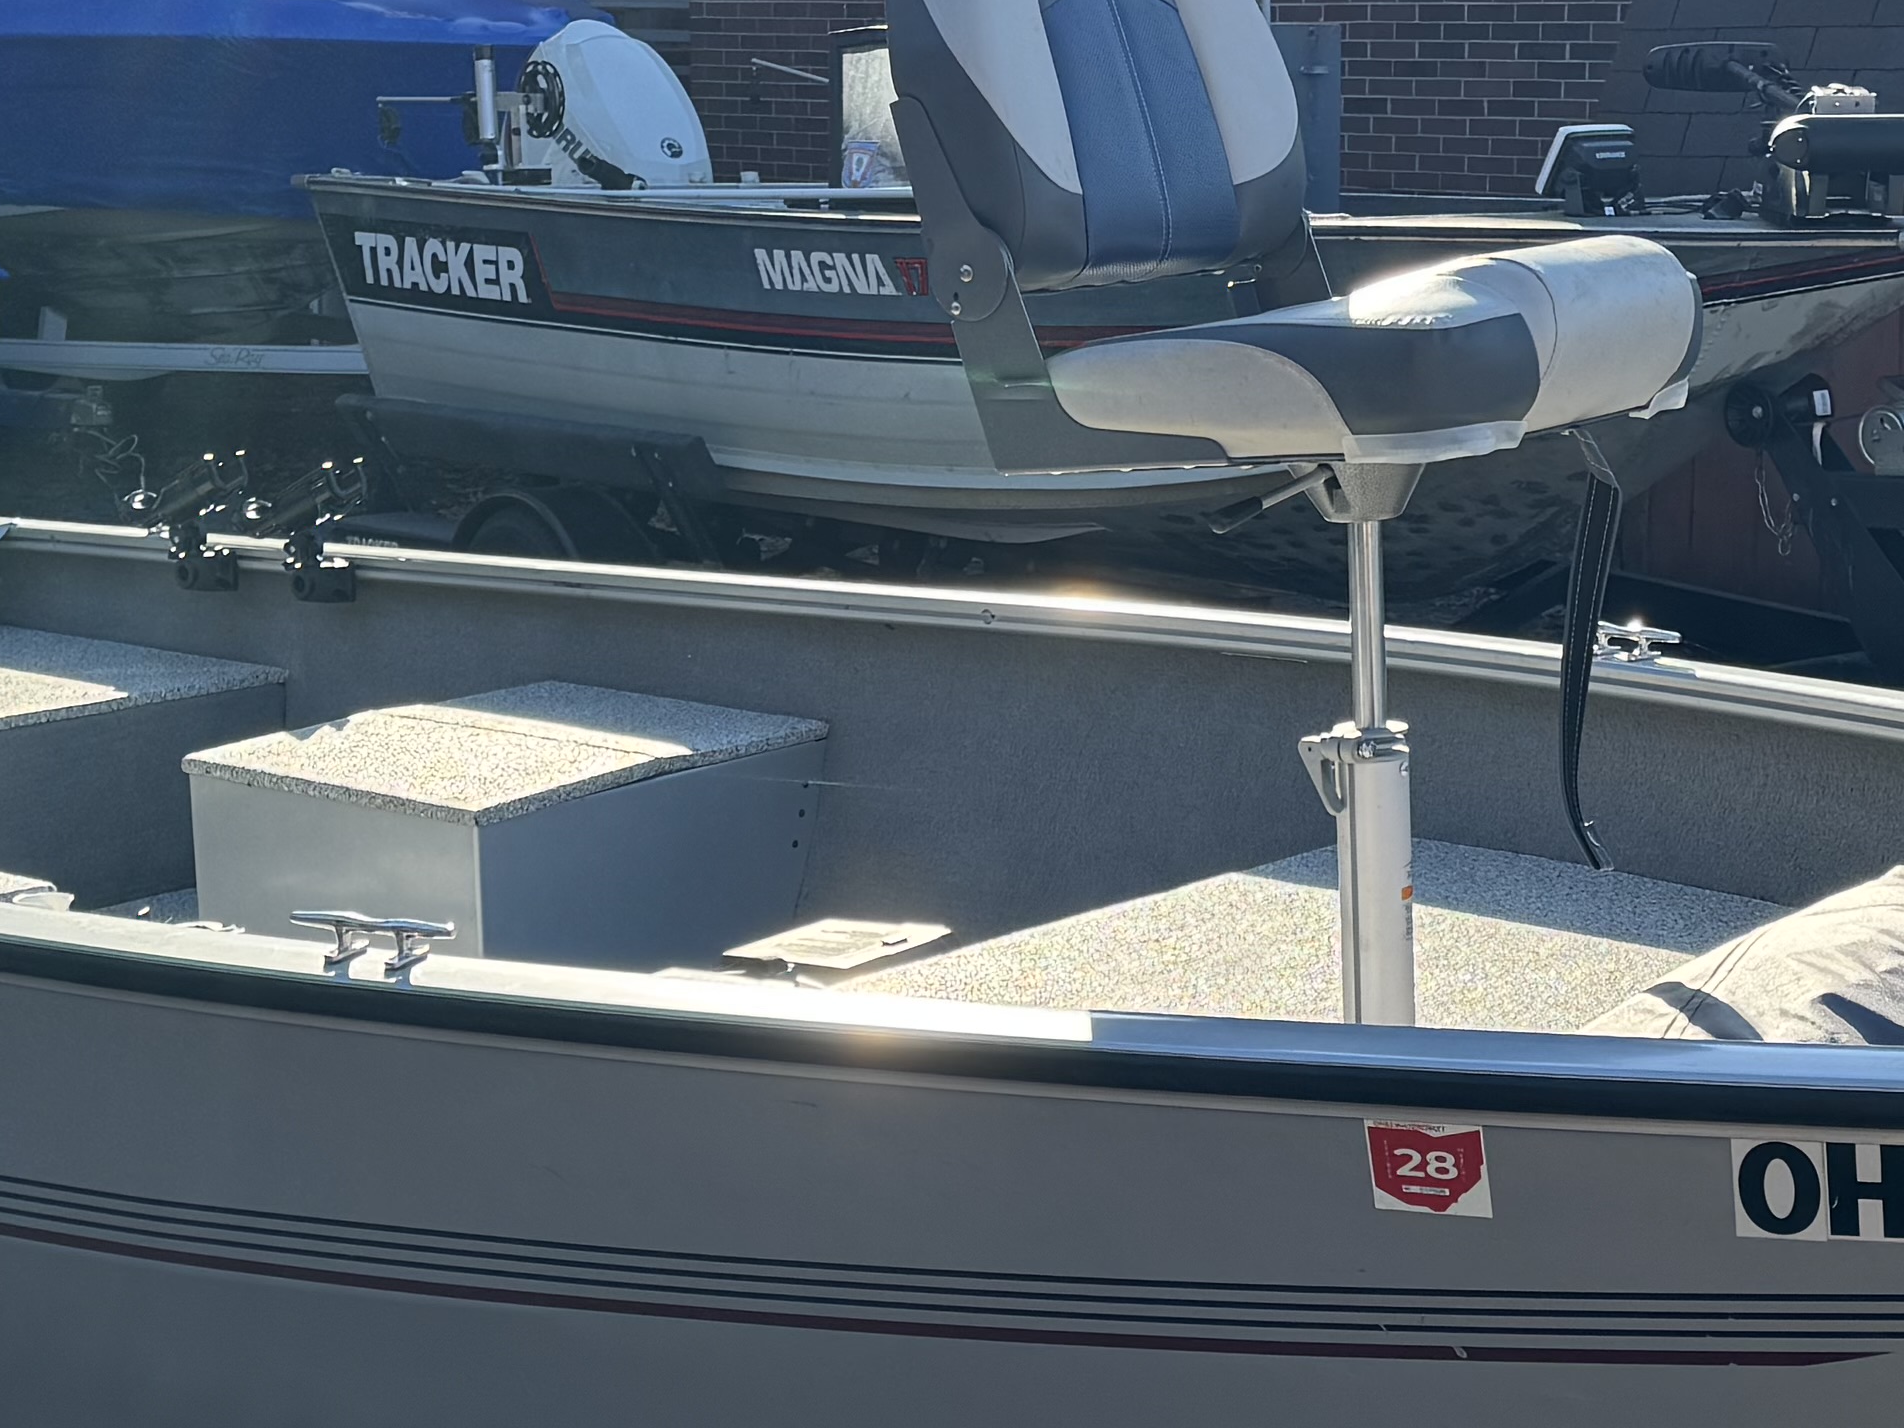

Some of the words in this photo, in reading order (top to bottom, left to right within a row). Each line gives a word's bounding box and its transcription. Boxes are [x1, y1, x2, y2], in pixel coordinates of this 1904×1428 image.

[353, 230, 529, 304] TRACKER
[754, 248, 902, 296] MAGNA
[1393, 1148, 1459, 1180] 28
